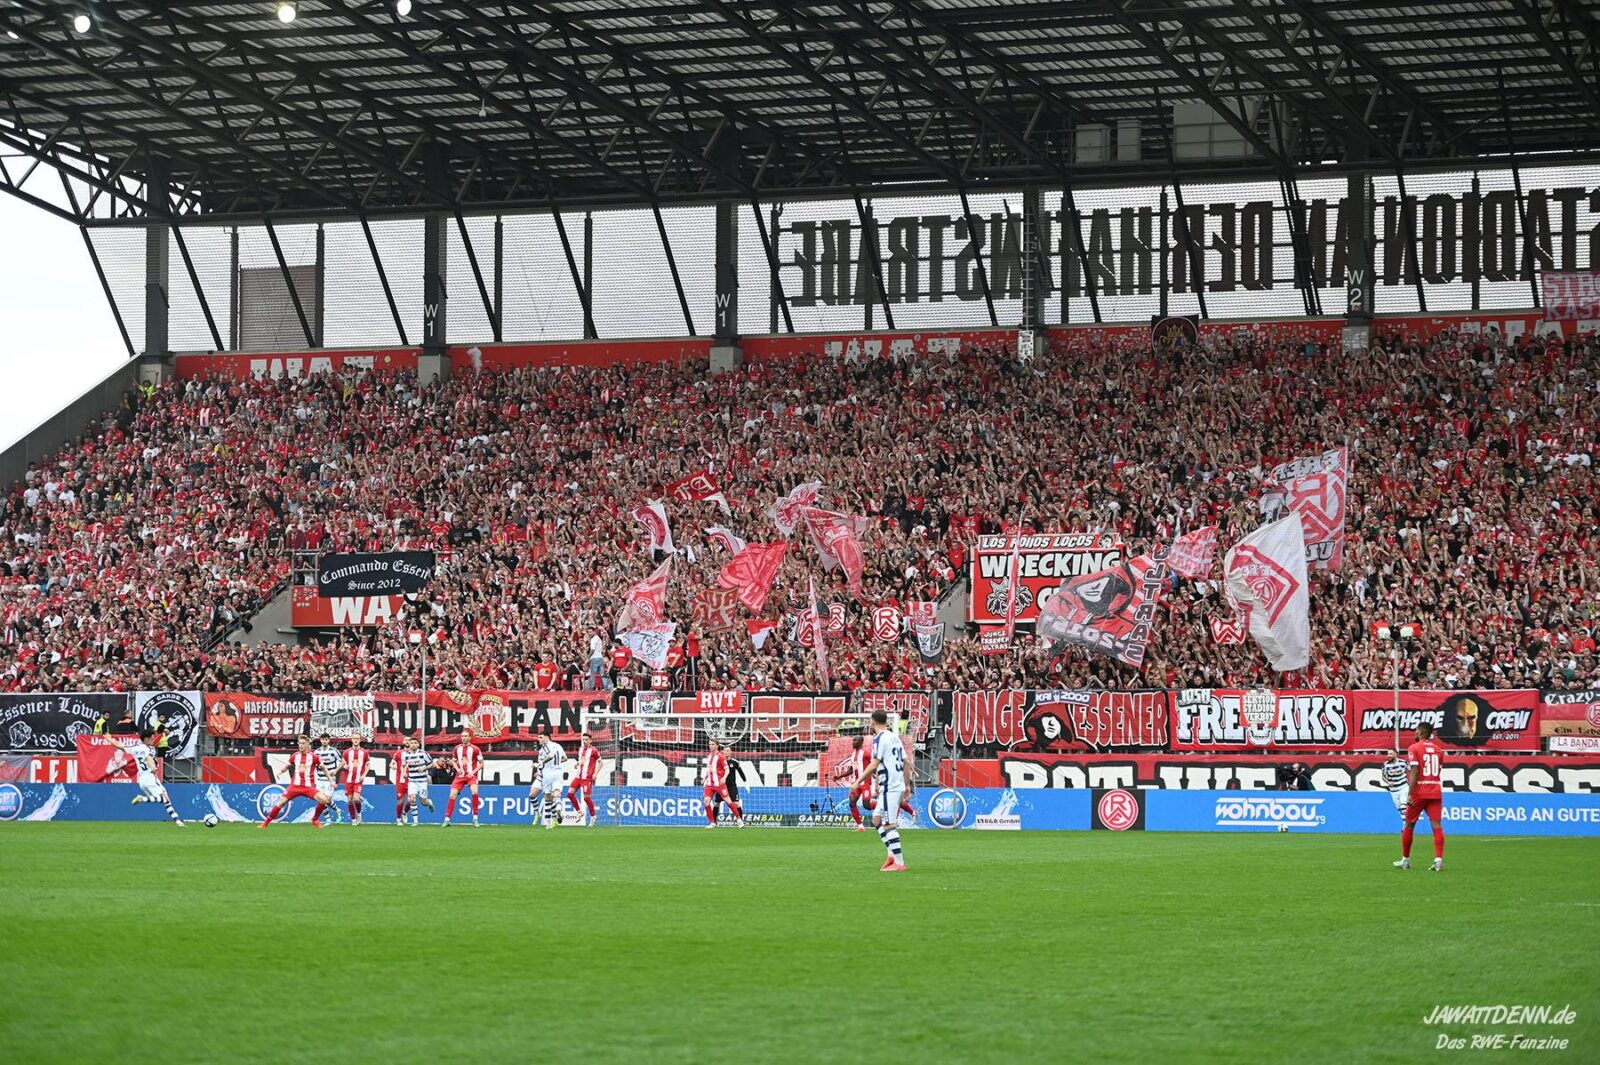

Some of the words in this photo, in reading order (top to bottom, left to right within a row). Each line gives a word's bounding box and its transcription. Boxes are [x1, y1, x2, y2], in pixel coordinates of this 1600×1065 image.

[1347, 270, 1364, 285] W
[716, 293, 730, 307] W
[1350, 288, 1362, 301] 2
[424, 304, 438, 317] W
[719, 311, 726, 327] 1
[427, 320, 433, 336] 1
[983, 539, 1007, 549] LOS
[1054, 536, 1094, 548] LOCOS
[320, 560, 388, 585] Commando
[392, 559, 431, 581] Essen
[979, 551, 1121, 578] WRECKING
[347, 580, 375, 590] Since
[377, 578, 401, 589] 2012
[700, 692, 737, 709] RVT
[1061, 692, 1090, 703] 2000
[376, 700, 464, 735] RUDE
[945, 690, 1027, 746] JUNGE
[1072, 690, 1168, 747] ESSENER
[1362, 710, 1445, 730] NORTHSIDE
[1486, 710, 1531, 729] CREW
[249, 717, 305, 735] ESSEN
[32, 733, 67, 748] 1980
[1558, 738, 1568, 747] LA
[1570, 738, 1599, 748] BANDA
[138, 757, 148, 771] 5
[1423, 754, 1440, 777] 30
[459, 797, 498, 816] SPT
[1485, 807, 1527, 821] SPAß
[1530, 808, 1554, 822] AN
